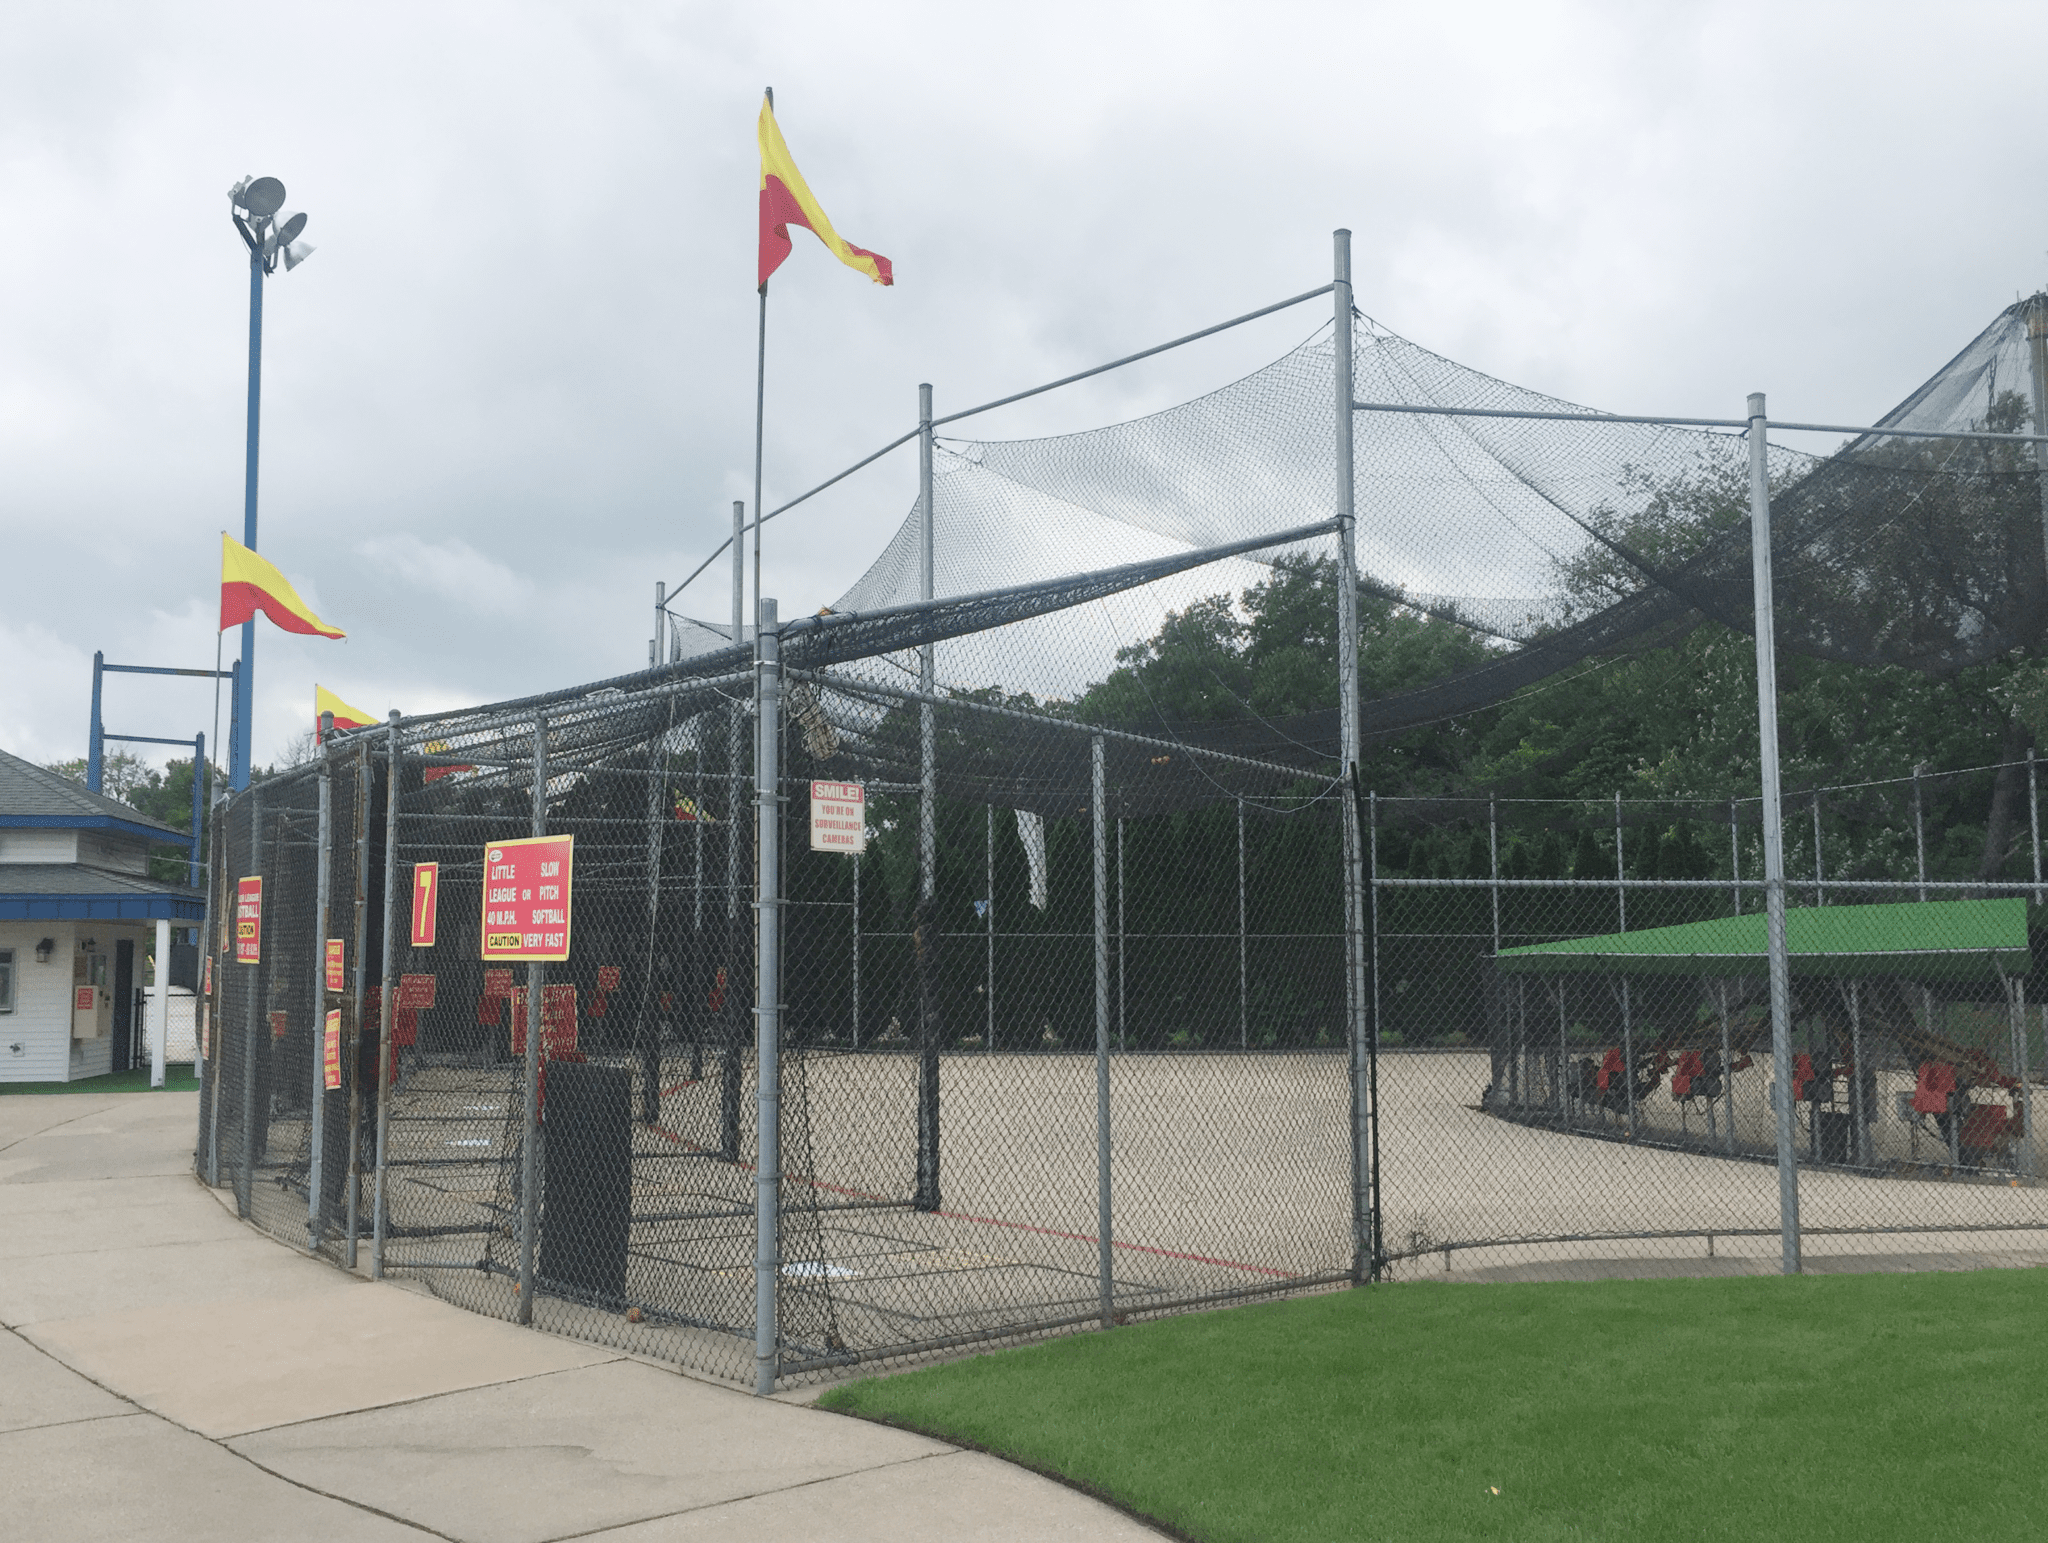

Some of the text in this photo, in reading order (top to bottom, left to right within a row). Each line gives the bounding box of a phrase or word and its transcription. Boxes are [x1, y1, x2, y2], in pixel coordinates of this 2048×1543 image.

[815, 784, 860, 800] SMILE!
[822, 804, 854, 816] YOU'RE ON
[815, 819, 861, 831] SURVEILLANCE
[822, 833, 854, 845] CAMERAS
[491, 862, 559, 880] LITTLE SLOW
[489, 885, 559, 902] LEAGUE OR PITCH
[419, 871, 433, 938] 7
[487, 908, 565, 925] 40 M.P.H. SOFTBALL
[489, 932, 564, 948] CAUTION VERY FAST
